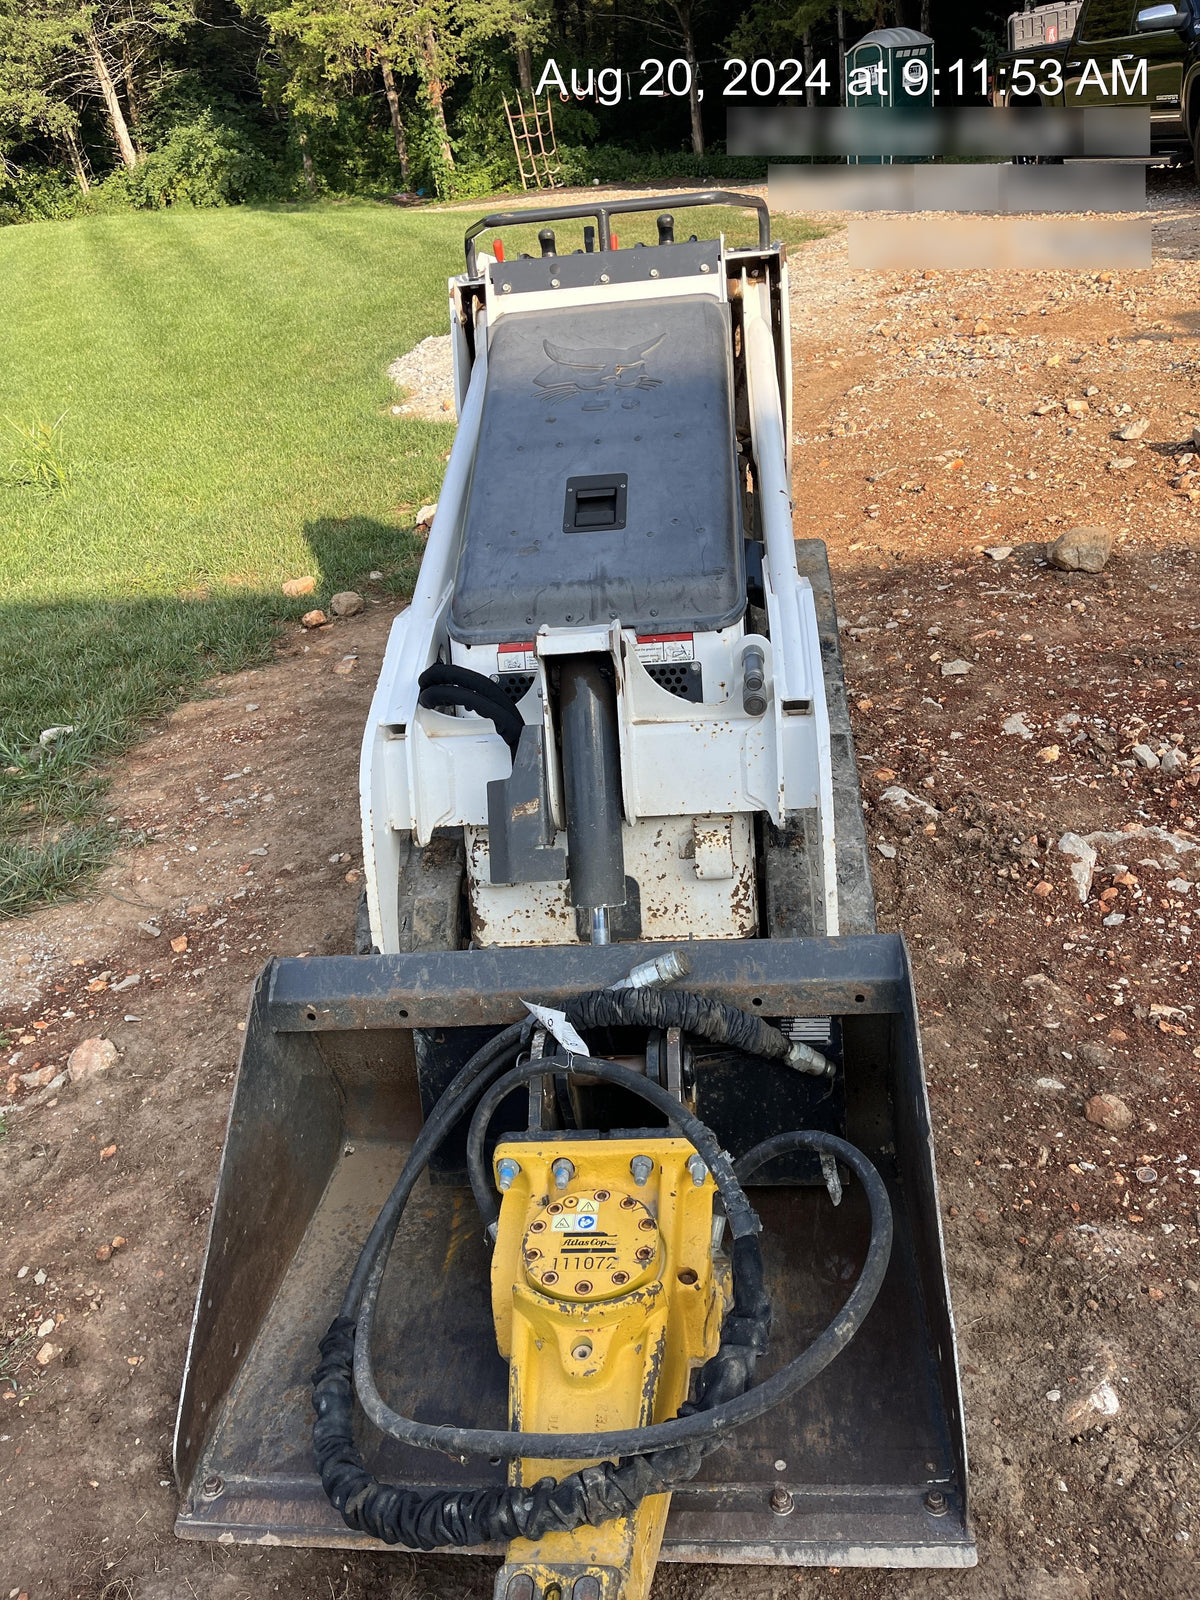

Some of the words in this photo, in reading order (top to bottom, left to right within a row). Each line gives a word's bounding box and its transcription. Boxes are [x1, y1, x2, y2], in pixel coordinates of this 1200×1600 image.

[562, 1238, 589, 1246] Atlas
[590, 1238, 617, 1247] Cop
[553, 1256, 619, 1270] 111072
